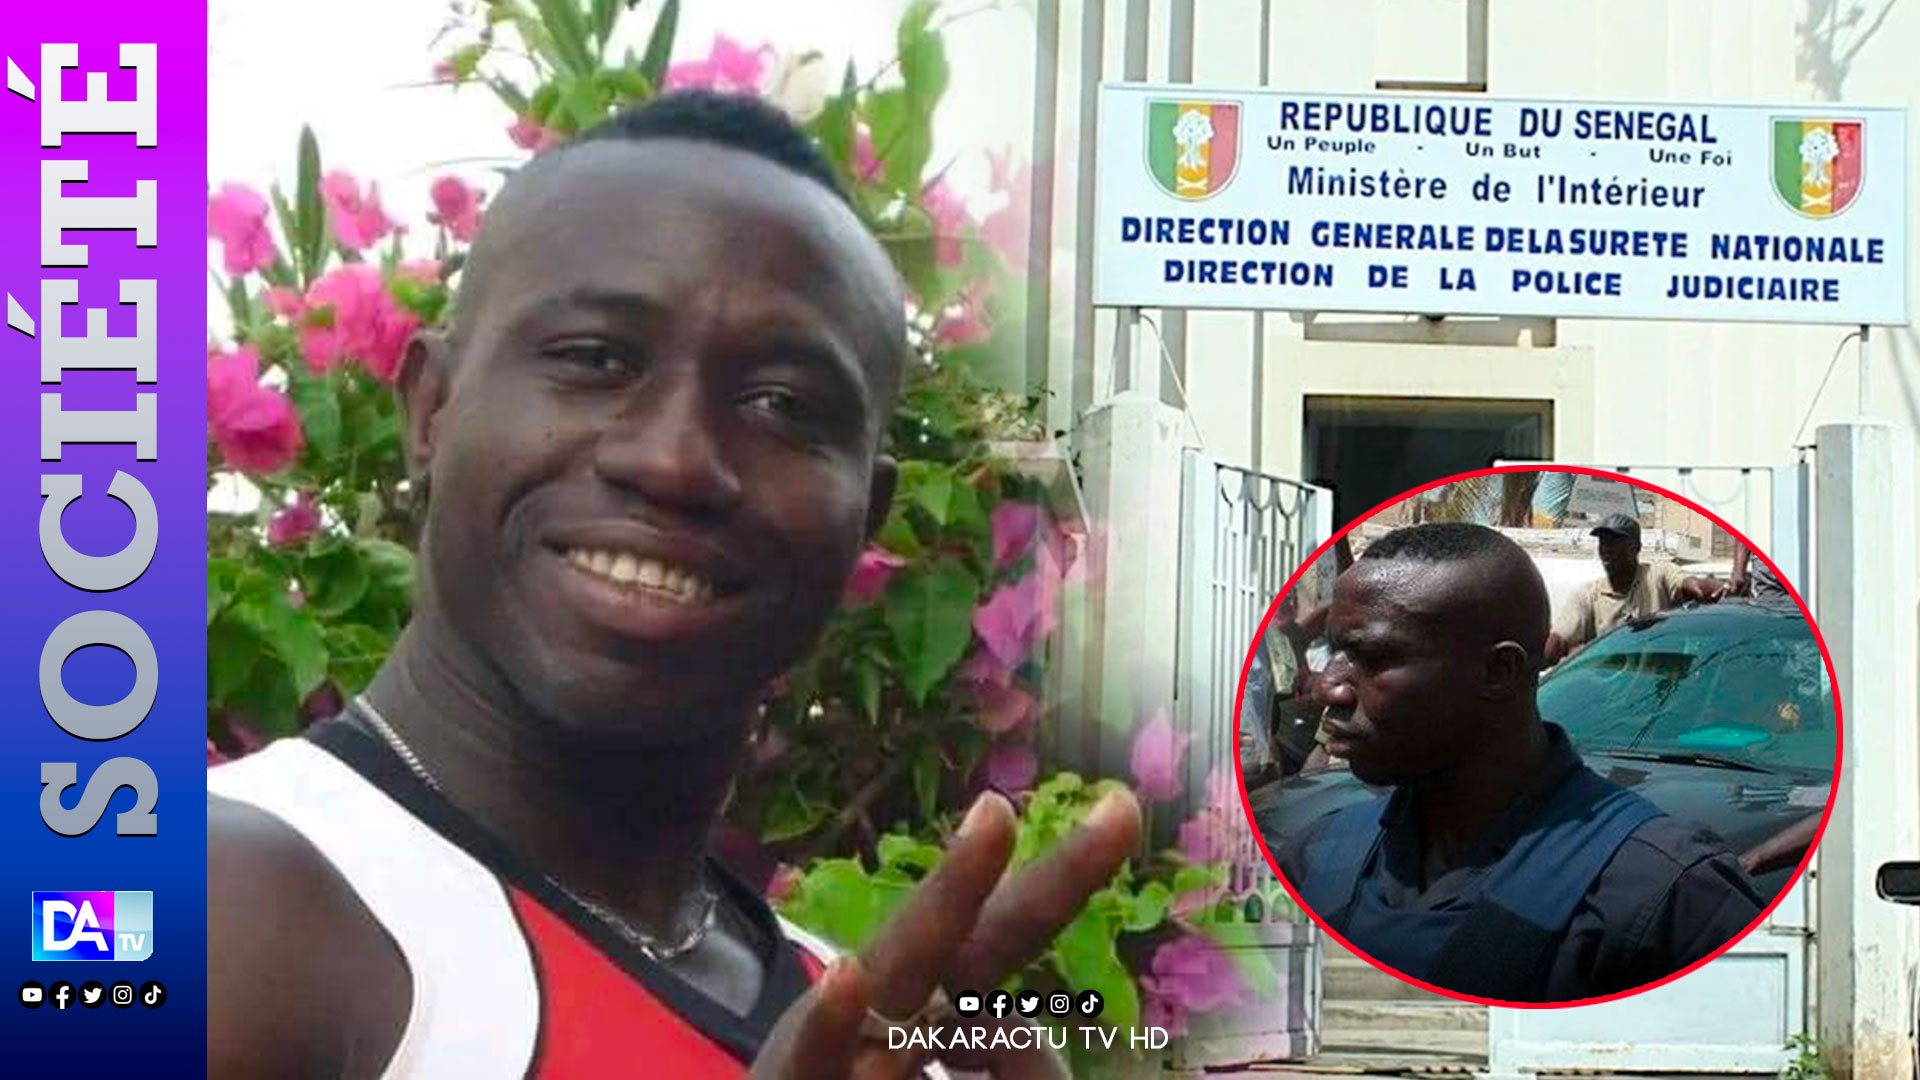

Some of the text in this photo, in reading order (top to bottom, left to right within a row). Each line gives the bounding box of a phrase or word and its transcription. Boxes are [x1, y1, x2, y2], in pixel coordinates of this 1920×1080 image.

[1278, 100, 1718, 144] REPUBLIQUE DU SENEGAL
[1267, 135, 1295, 151] Un
[1304, 137, 1376, 156] Peuple
[1465, 141, 1494, 157] Un
[1503, 143, 1541, 159] But
[1649, 148, 1691, 164] Une
[1700, 150, 1732, 167] Foi
[1288, 165, 1706, 208] Ministère de l'Intérieur
[1121, 216, 1290, 246] DIRECTION
[1311, 220, 1475, 251] GENERALE
[1711, 233, 1884, 264] NATIONALE
[1164, 259, 1839, 302] DIRECTION DE LA POLICE JUDICIAIRE
